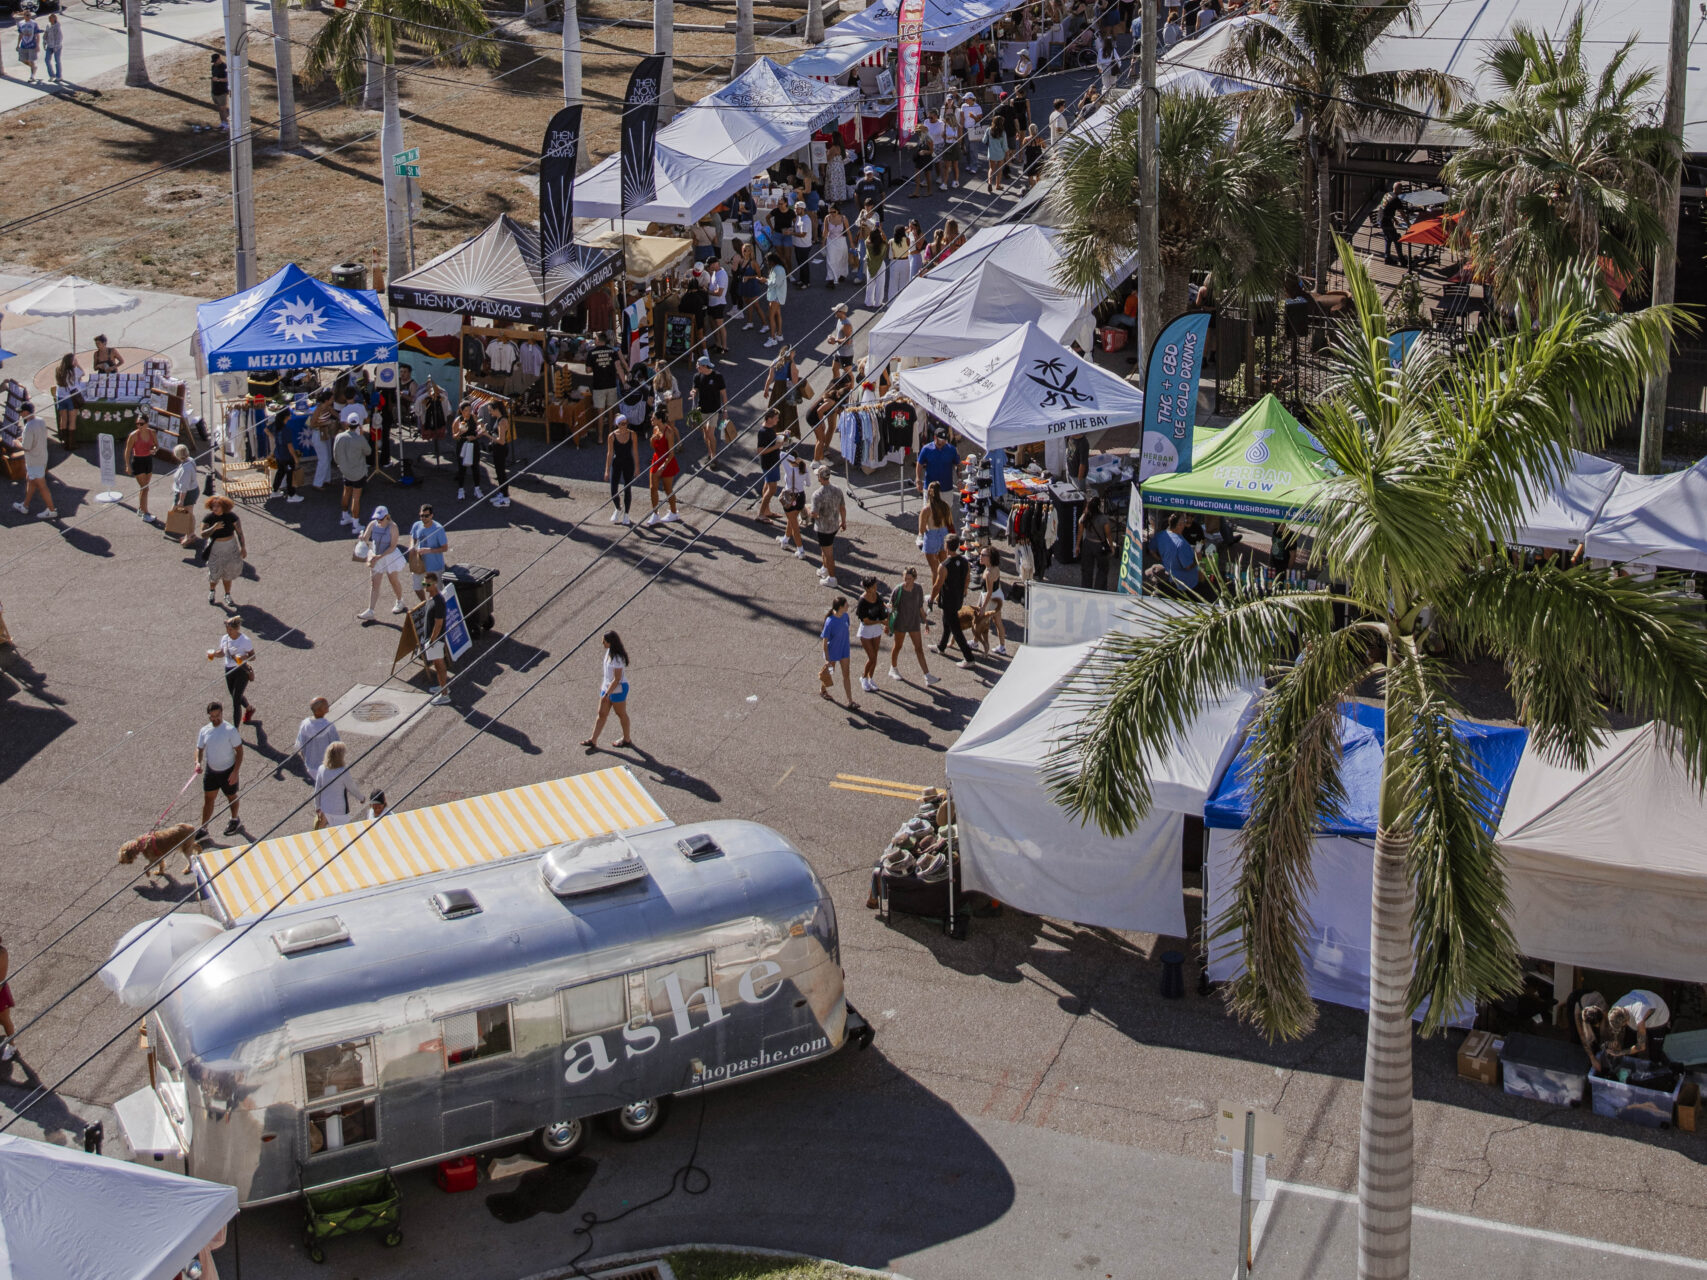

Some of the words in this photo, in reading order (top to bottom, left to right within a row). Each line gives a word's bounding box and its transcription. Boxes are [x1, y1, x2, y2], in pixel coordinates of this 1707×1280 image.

[248, 352, 297, 368] MEZZO
[300, 349, 359, 365] MARKET
[1162, 343, 1179, 376] CBD
[1180, 330, 1199, 380] DRINKS
[1157, 394, 1173, 425] THC
[1176, 382, 1191, 418] COLD
[1048, 423, 1066, 434] FOR
[1069, 420, 1086, 432] THE
[1089, 416, 1109, 428] BAY
[1173, 419, 1186, 440] ICE
[1143, 452, 1174, 463] HERBAN
[1147, 459, 1168, 467] FLOW
[1214, 465, 1292, 485] HERBAN
[1224, 478, 1275, 492] FLOW
[1149, 496, 1162, 504] THC
[1170, 497, 1184, 506] CBD
[1189, 499, 1232, 511] FUNCTIONAL
[1234, 504, 1280, 516] MUSHROOMS
[563, 959, 784, 1085] ashe
[691, 1036, 828, 1084] shopashe.com
